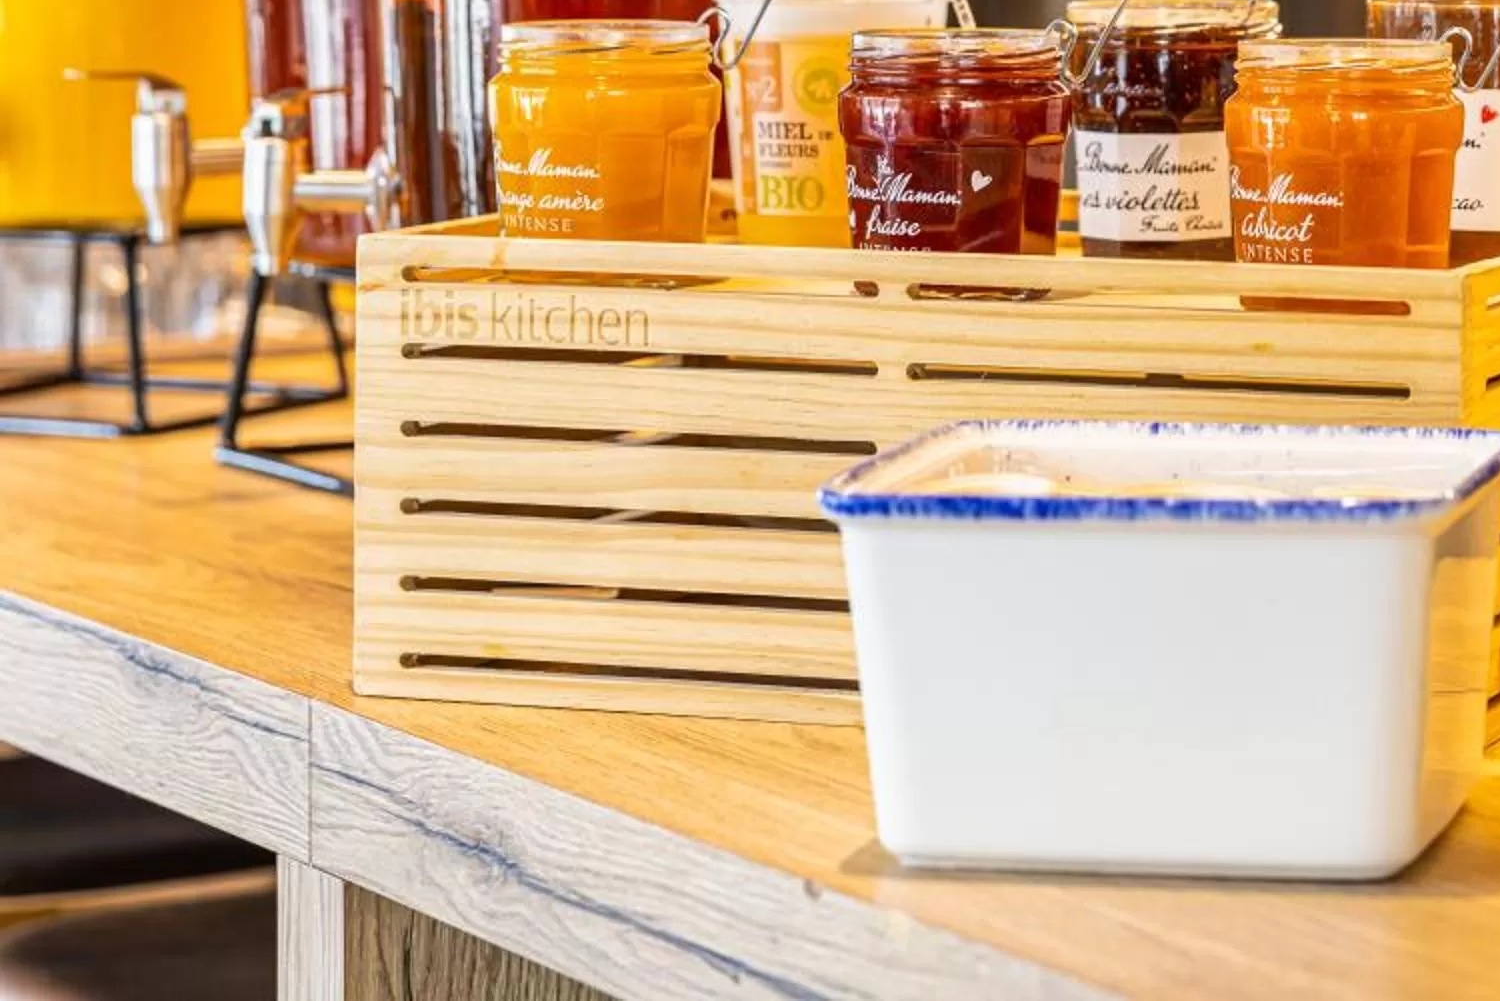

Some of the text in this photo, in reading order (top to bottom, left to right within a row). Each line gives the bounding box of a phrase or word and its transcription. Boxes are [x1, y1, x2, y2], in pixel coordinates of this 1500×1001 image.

[758, 121, 813, 140] MIEL
[527, 147, 601, 178] Maman
[758, 143, 819, 158] FLEURS
[1078, 141, 1217, 175] Bonne Maman
[538, 189, 605, 212] amère
[759, 174, 825, 211] BIO
[880, 172, 961, 205] Maman
[1104, 184, 1202, 212] violettes
[1267, 173, 1344, 207] Maman
[504, 214, 574, 232] INTENSE
[866, 204, 921, 240] fraise
[1241, 206, 1315, 241] abricot
[1241, 243, 1313, 263] INTENSE
[400, 288, 650, 347] ibis kitchen
